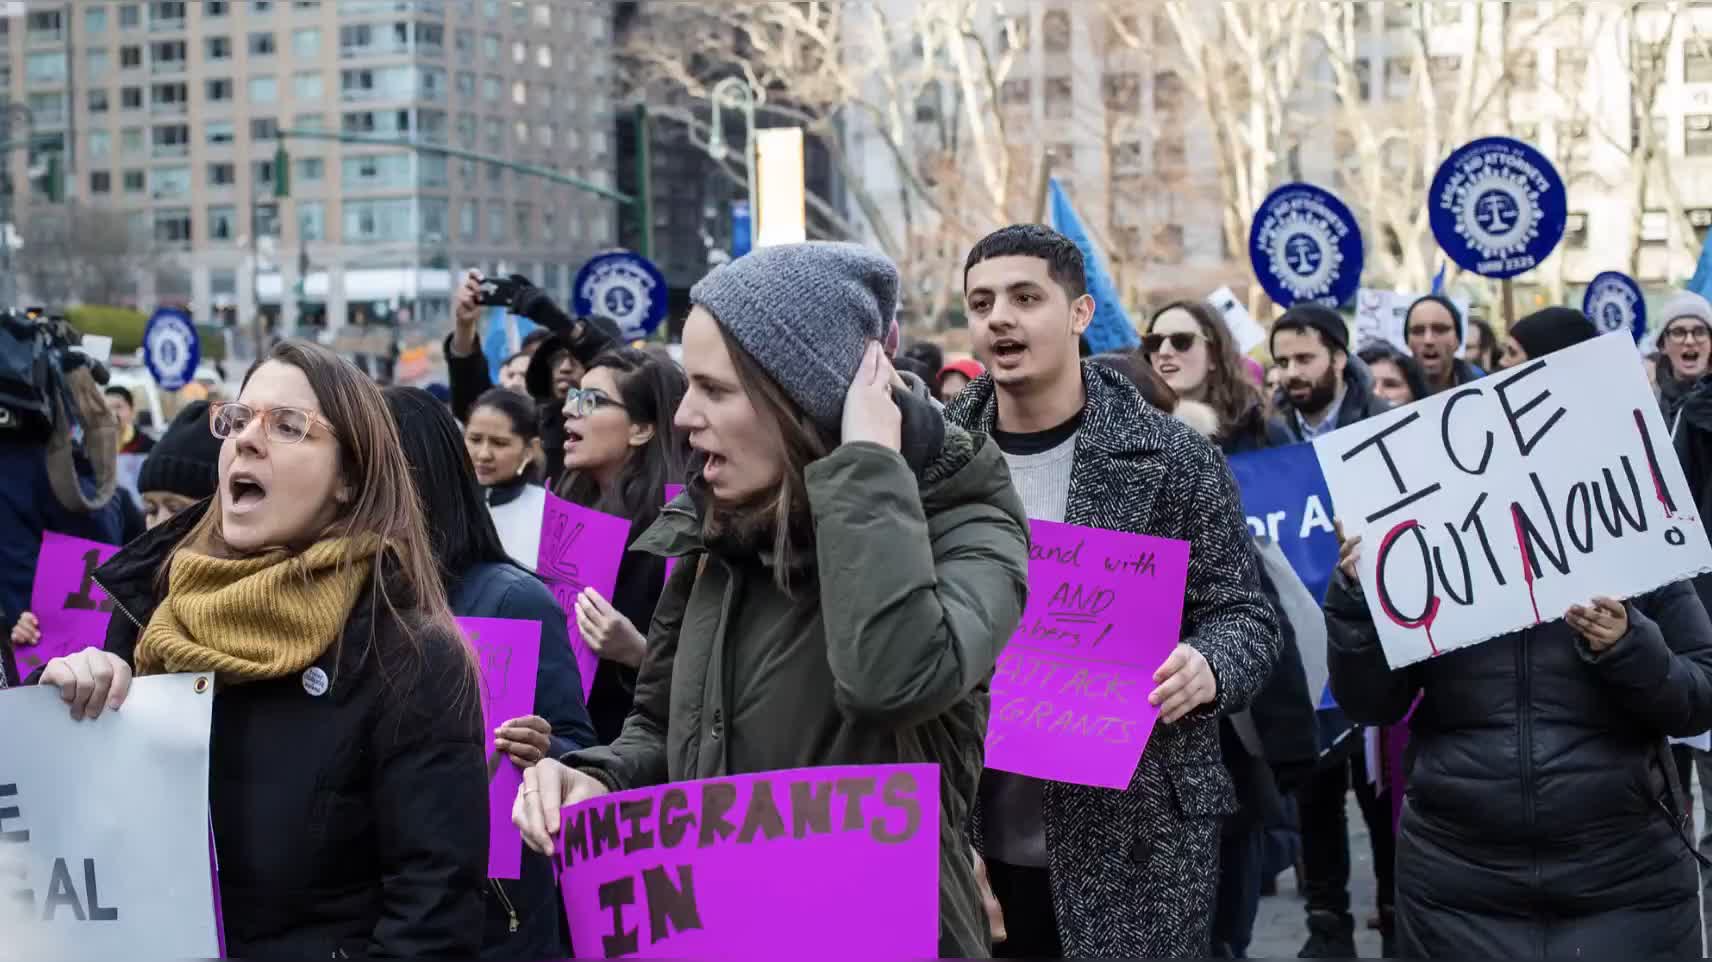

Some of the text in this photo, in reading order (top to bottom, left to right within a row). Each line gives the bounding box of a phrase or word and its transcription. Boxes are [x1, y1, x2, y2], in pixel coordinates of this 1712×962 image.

[1342, 360, 1567, 523] ICE
[1047, 582, 1115, 616] AND
[1104, 552, 1156, 577] with
[1376, 491, 1507, 629] OUT
[598, 864, 704, 959] IN
